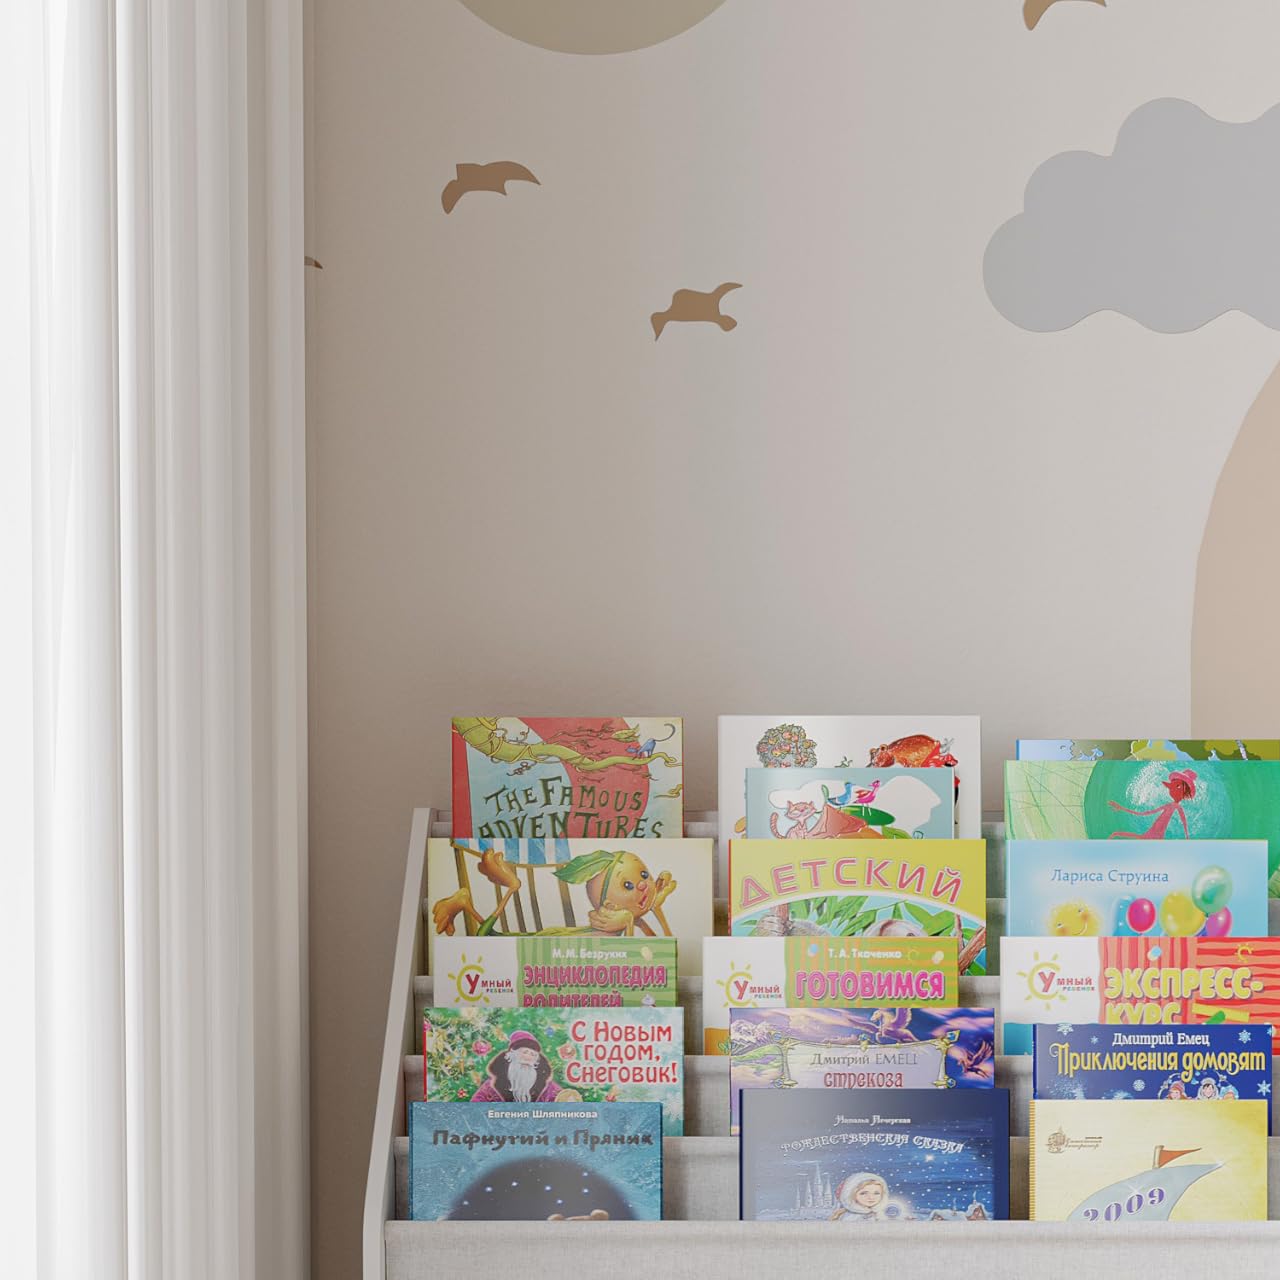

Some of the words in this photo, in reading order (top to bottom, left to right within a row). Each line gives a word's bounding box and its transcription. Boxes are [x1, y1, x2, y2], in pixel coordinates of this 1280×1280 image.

[484, 784, 537, 816] THE
[538, 776, 643, 812] FAMOUS
[478, 811, 664, 838] ADVENTURES
[740, 857, 963, 908] ДЕТСКИЙ
[1051, 869, 1103, 883] Лариса
[1108, 869, 1169, 883] Струина
[523, 965, 667, 988] ЭНЦИКЛОПЕДИЯ
[795, 971, 945, 1000] ГОТОВИМСЯ
[1104, 967, 1265, 1000] ЭКСПРЕСС-
[1105, 1002, 1182, 1024] КУРС
[572, 1021, 586, 1042] С
[594, 1021, 672, 1042] Новым
[1112, 1032, 1173, 1047] Дмитрий
[1177, 1032, 1210, 1047] Емец
[584, 1045, 661, 1064] годом,
[810, 1053, 870, 1066] Дмитрий
[1050, 1042, 1178, 1077] Приключения
[1182, 1050, 1266, 1082] домовят
[566, 1062, 678, 1083] Снеговик!
[488, 1110, 529, 1119] Евгения
[532, 1110, 598, 1119] Шляпникова
[432, 1129, 549, 1150] Пафнутий
[554, 1135, 568, 1145] и
[572, 1129, 654, 1150] Пряник
[1083, 1187, 1165, 1221] 2009
